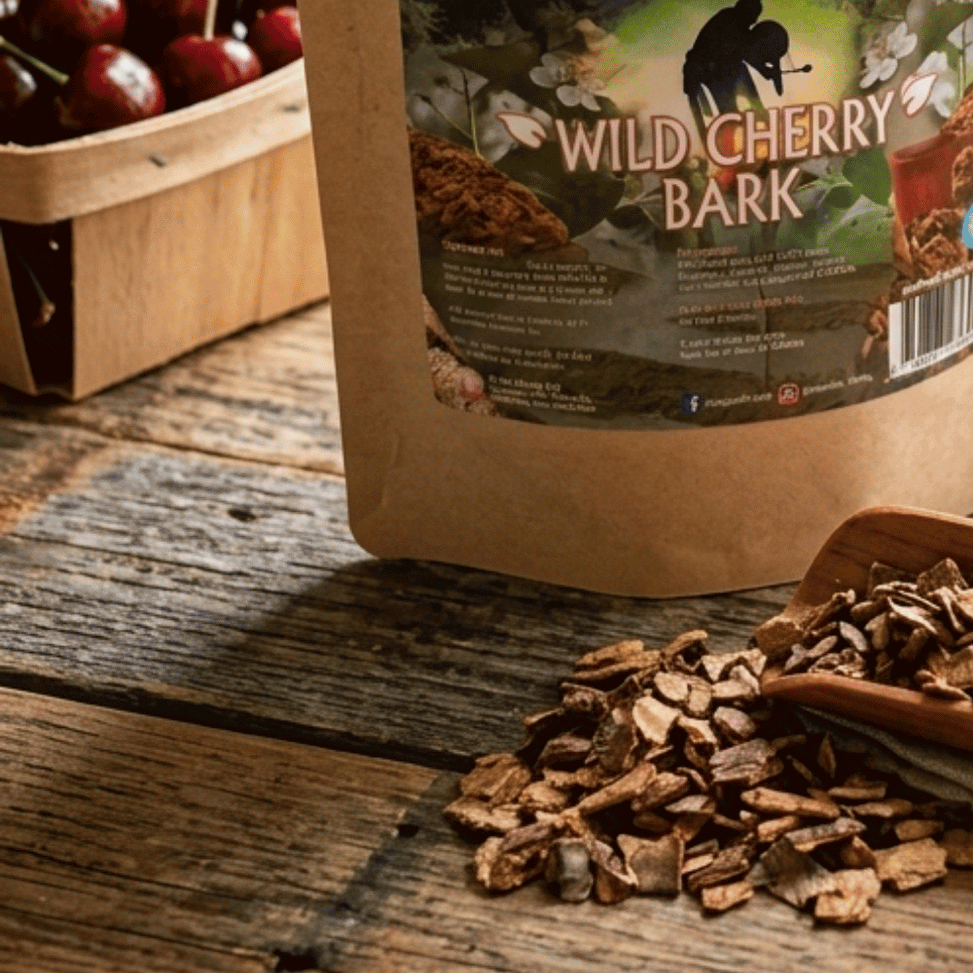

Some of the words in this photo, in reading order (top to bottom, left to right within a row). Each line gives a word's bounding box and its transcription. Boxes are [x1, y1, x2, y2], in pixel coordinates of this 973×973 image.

[554, 115, 692, 174] WILD
[705, 89, 897, 167] CHERRY
[662, 166, 805, 232] BARK
